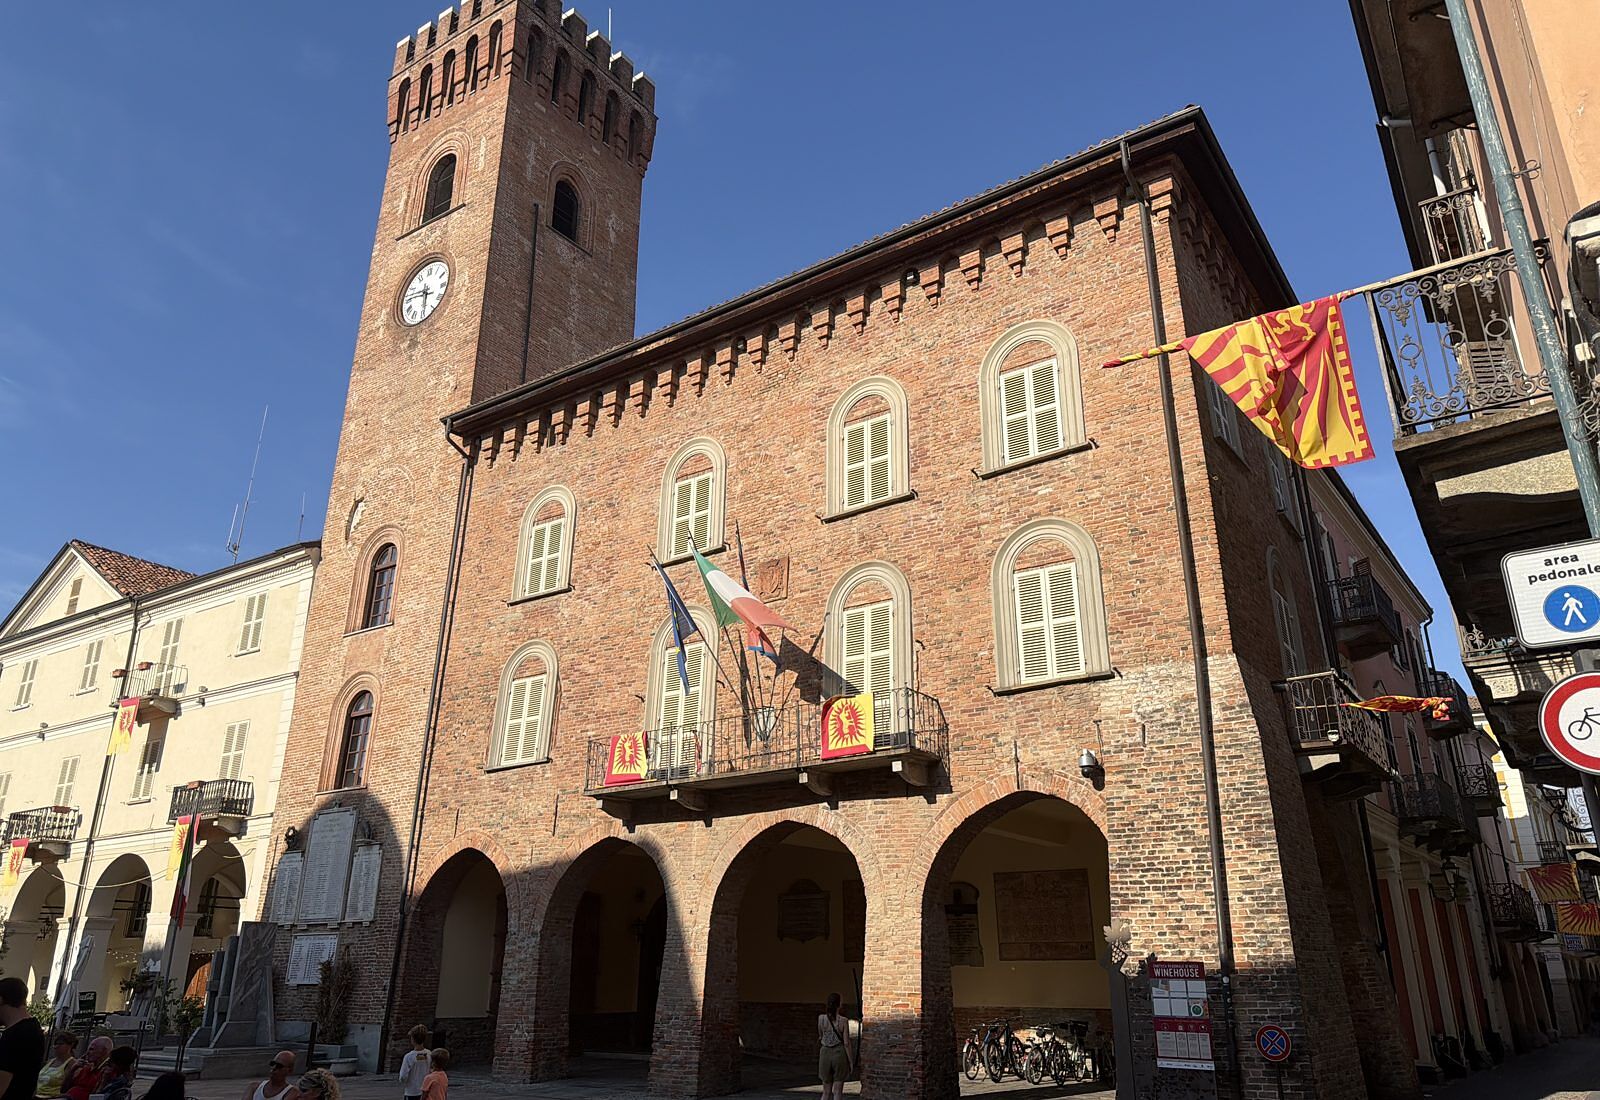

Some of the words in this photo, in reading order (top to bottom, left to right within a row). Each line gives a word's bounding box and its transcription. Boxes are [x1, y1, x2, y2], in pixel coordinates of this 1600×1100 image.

[1543, 554, 1580, 567] area
[1528, 563, 1600, 585] pedonale
[1153, 968, 1200, 978] WINEHOUSE
